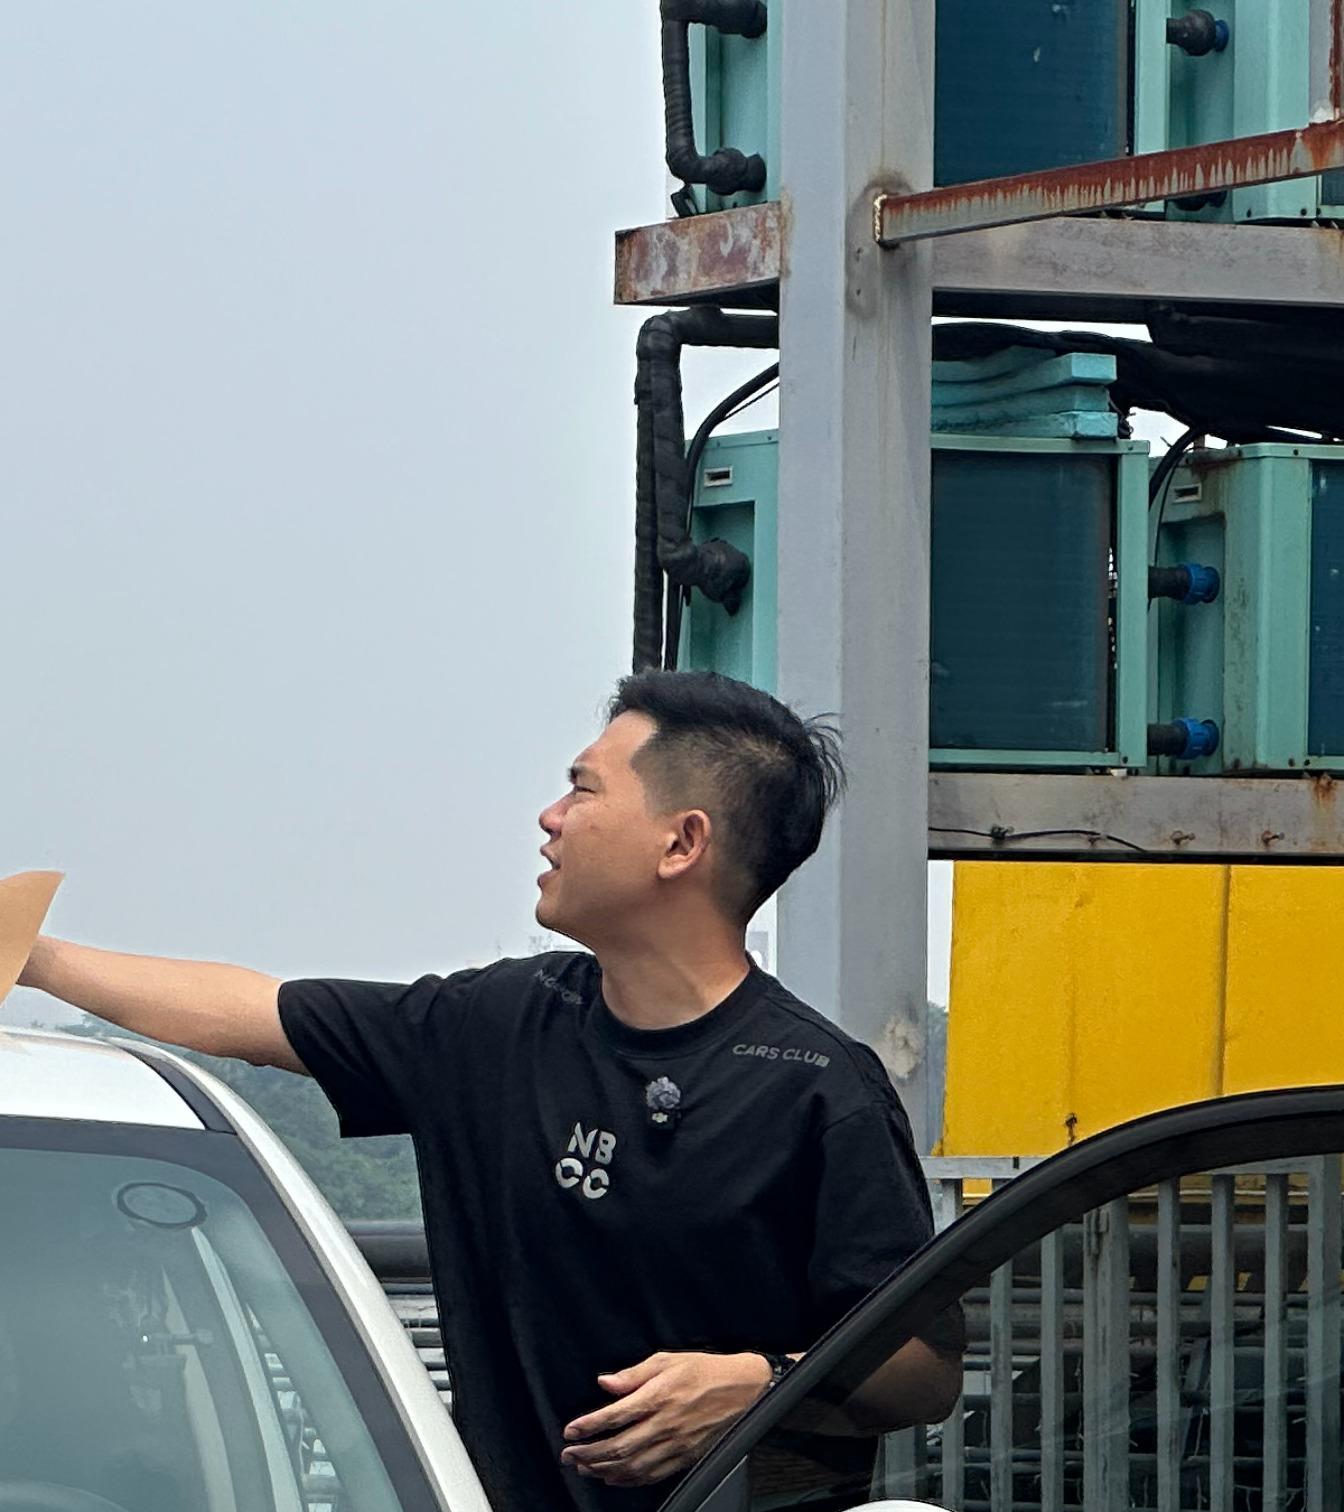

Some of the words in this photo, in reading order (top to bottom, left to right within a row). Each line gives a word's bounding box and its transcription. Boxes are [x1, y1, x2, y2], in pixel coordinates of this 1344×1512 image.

[732, 1043, 780, 1060] CARS
[782, 1048, 830, 1067] CLUB
[566, 1121, 617, 1165] NB
